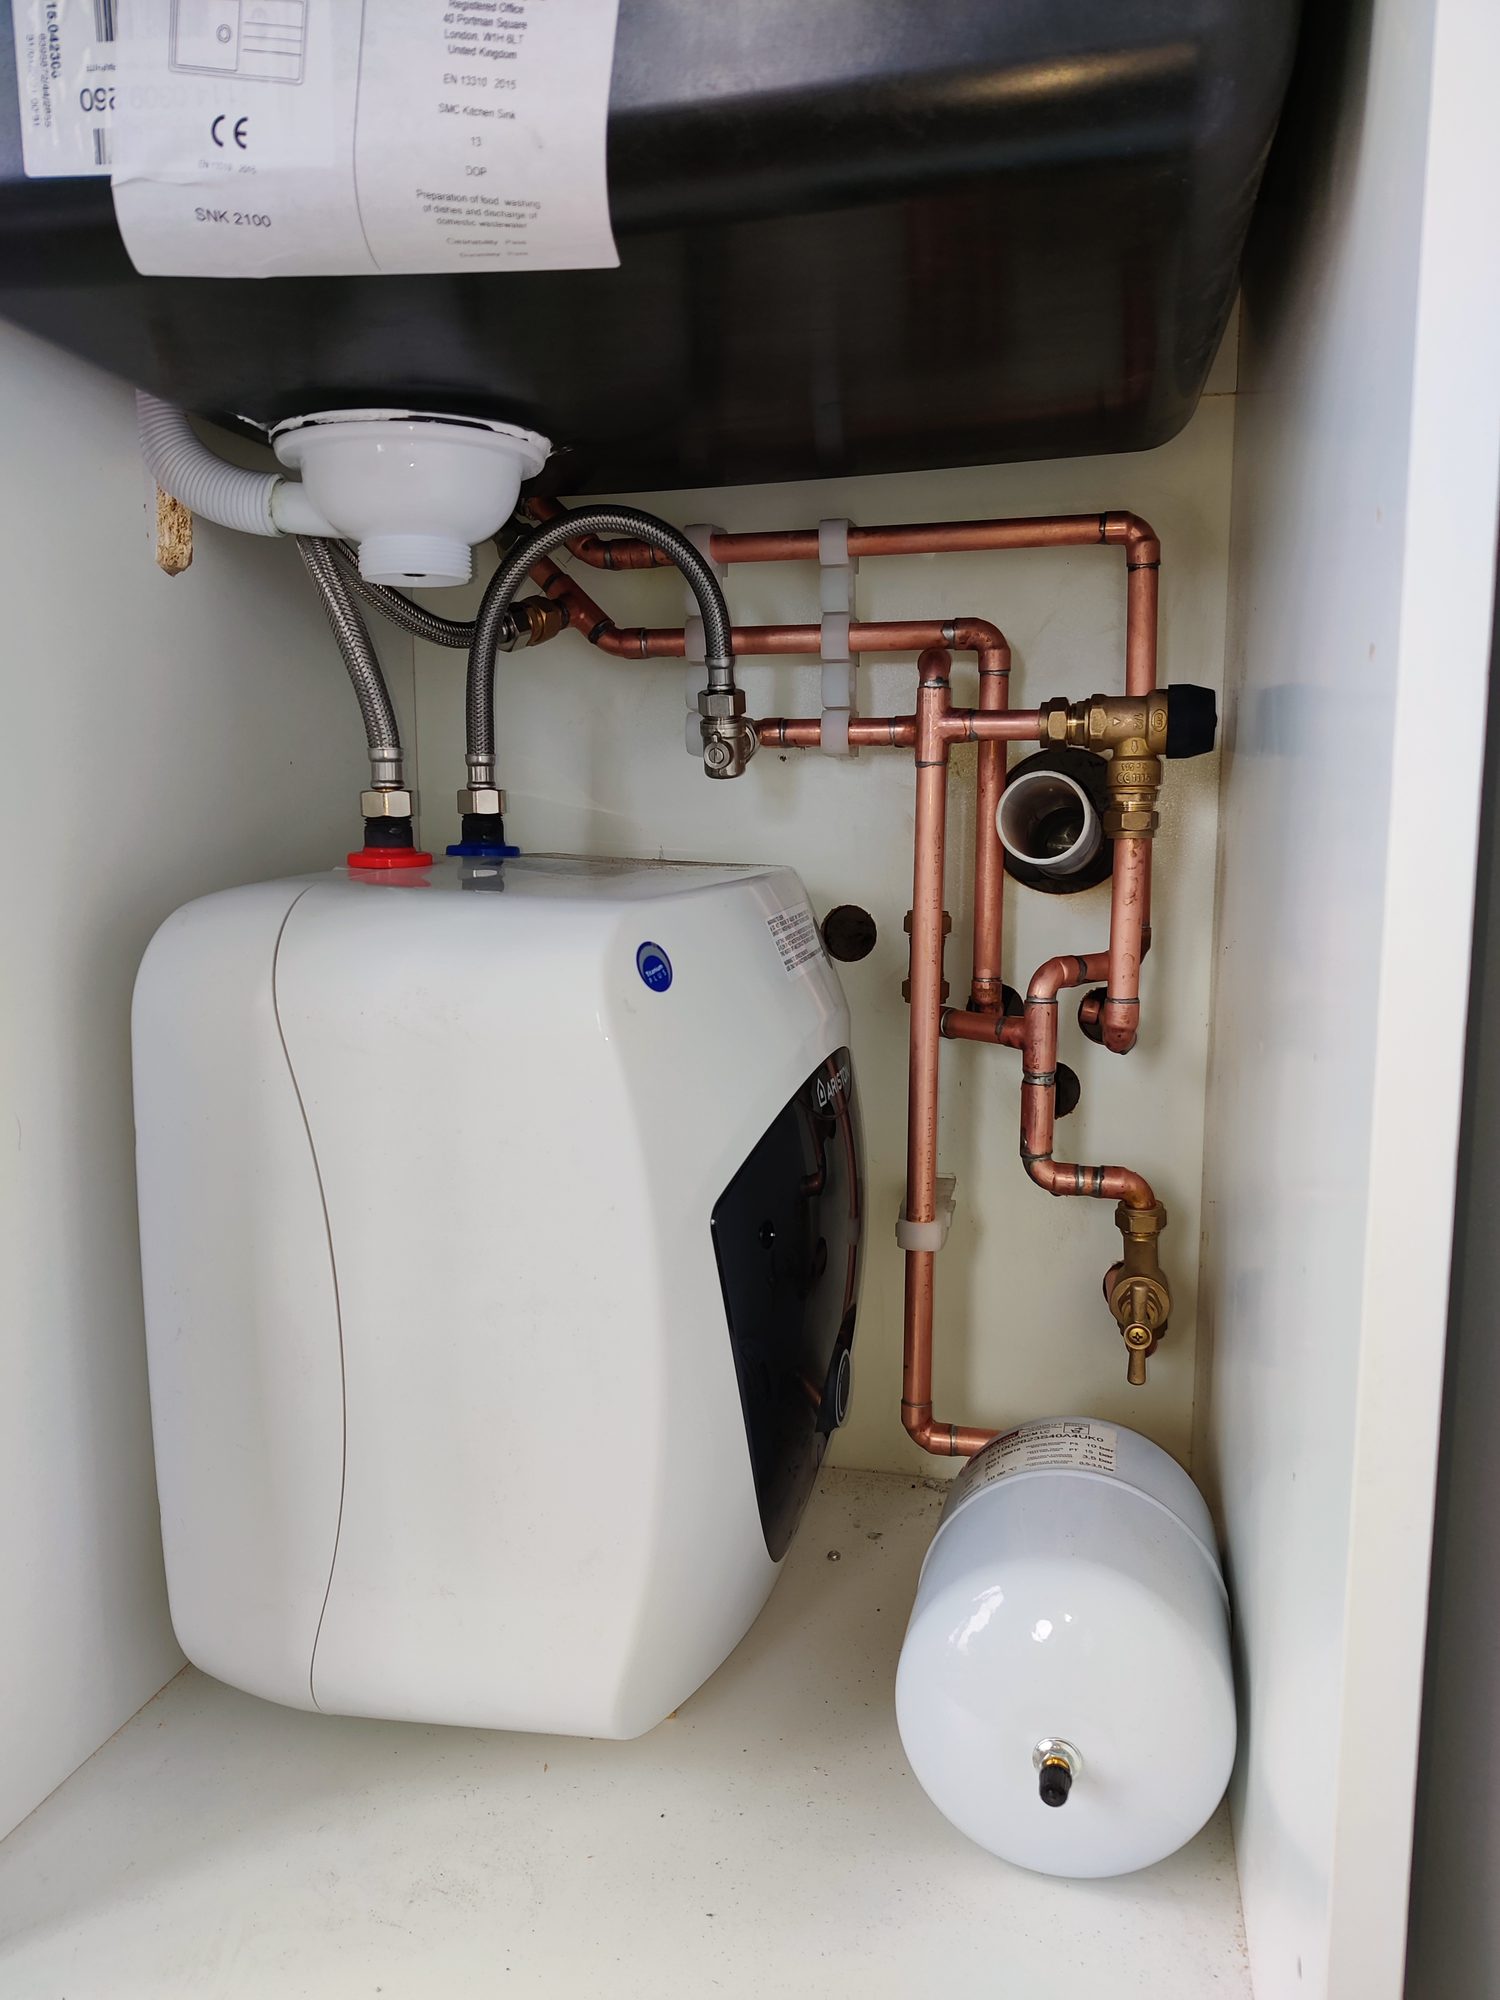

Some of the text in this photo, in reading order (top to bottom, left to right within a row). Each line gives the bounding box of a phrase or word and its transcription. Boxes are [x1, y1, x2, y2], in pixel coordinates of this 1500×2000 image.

[443, 73, 458, 85] EN
[194, 207, 272, 228] SNK 2100
